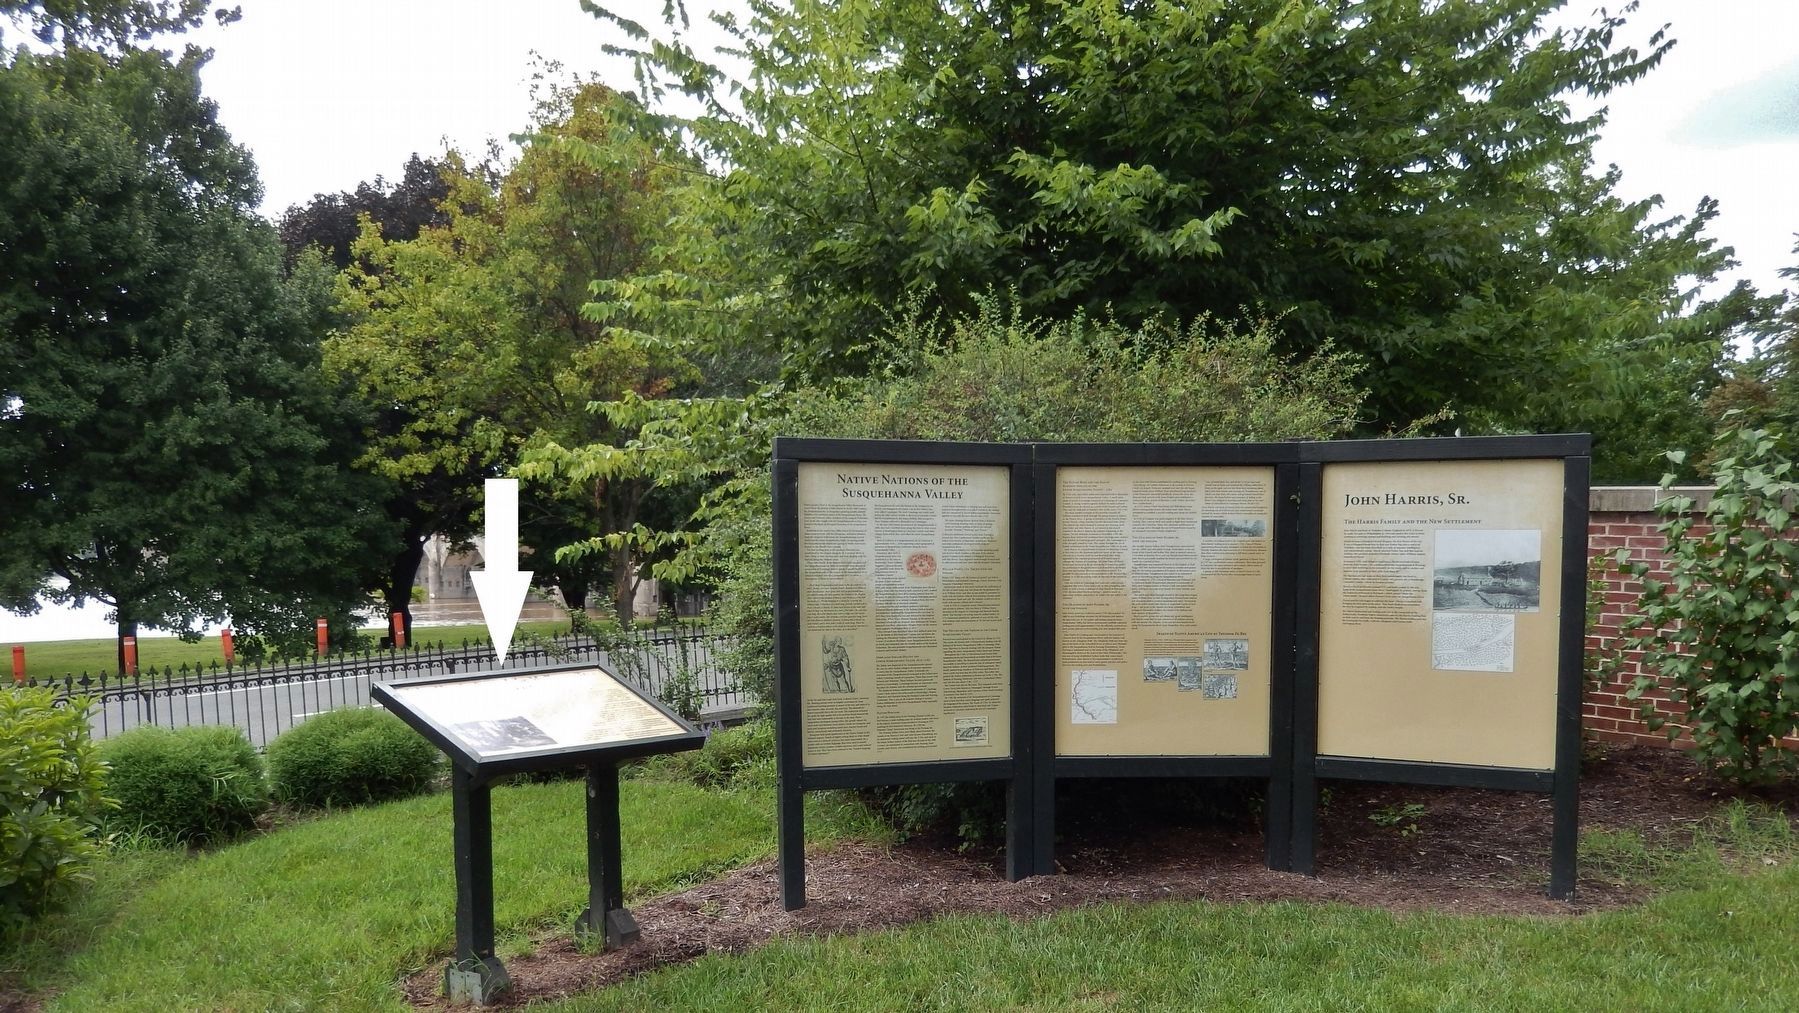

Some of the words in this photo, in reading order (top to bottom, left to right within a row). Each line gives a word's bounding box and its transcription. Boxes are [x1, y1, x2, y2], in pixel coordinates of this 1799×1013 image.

[837, 474, 879, 485] NATIVE
[881, 474, 929, 485] NATIONS
[947, 478, 968, 486] THE
[842, 488, 921, 499] SUSQUEHANNA
[924, 489, 963, 499] VALLEY
[1345, 494, 1380, 507] JOHN
[1384, 494, 1444, 506] HARRIS,
[1447, 492, 1470, 505] SR.
